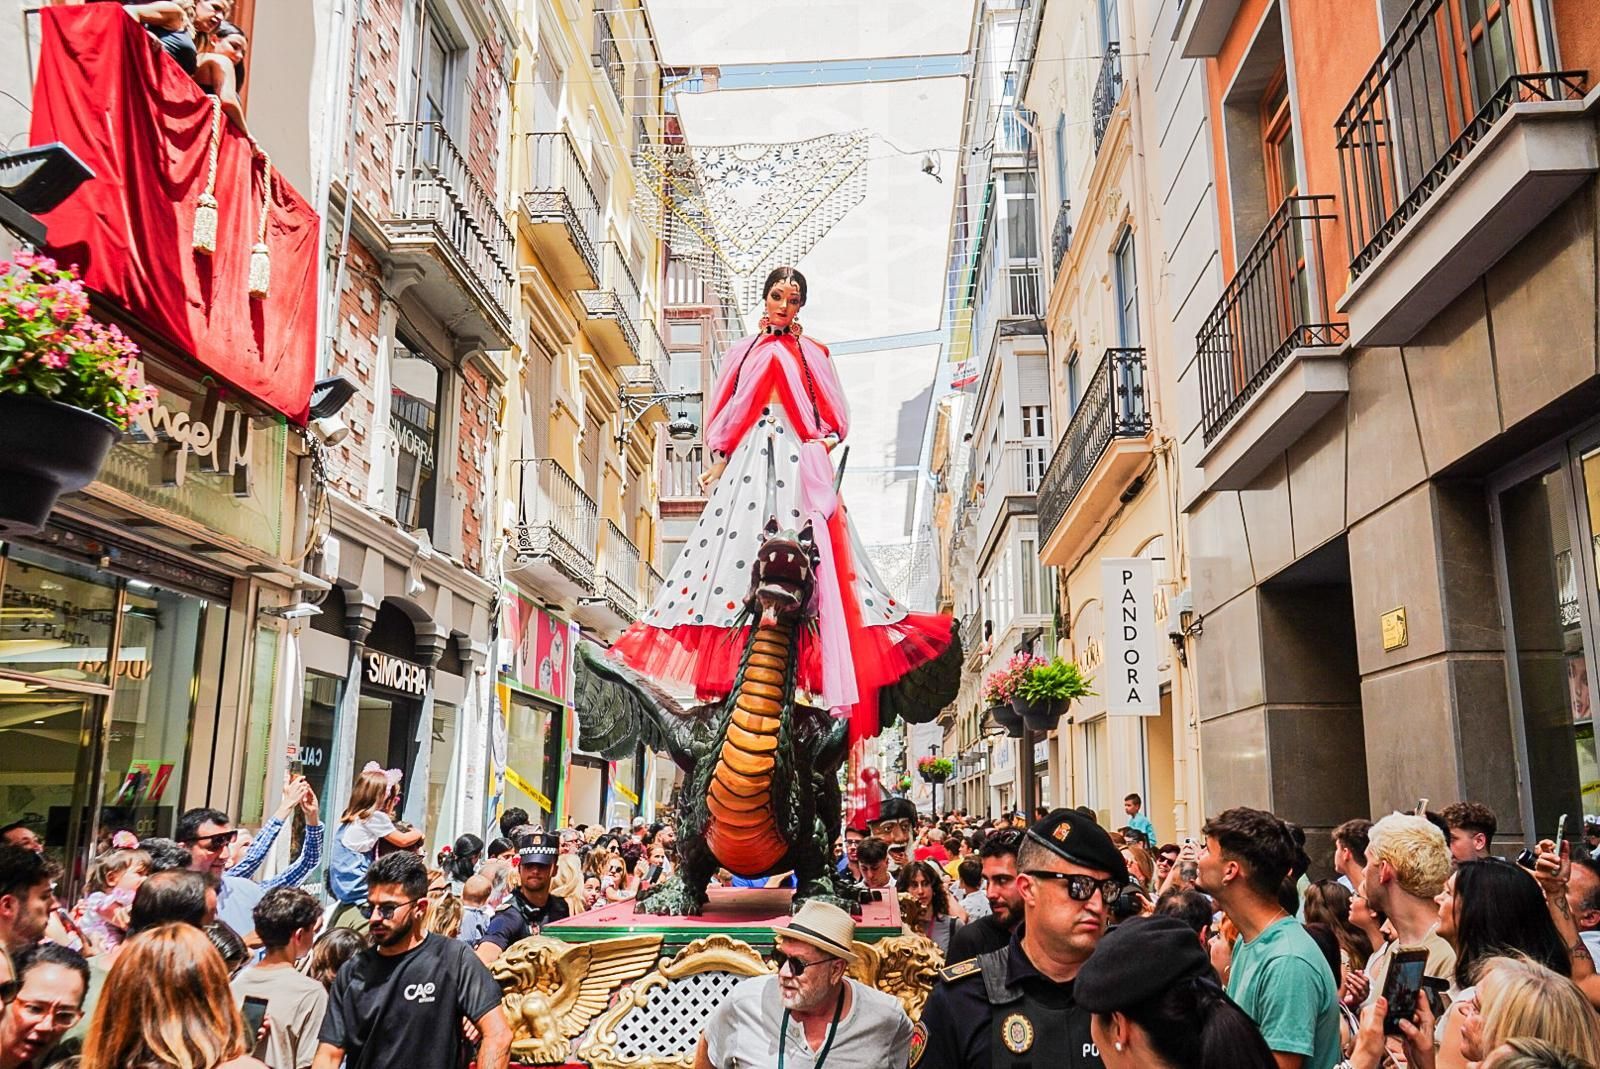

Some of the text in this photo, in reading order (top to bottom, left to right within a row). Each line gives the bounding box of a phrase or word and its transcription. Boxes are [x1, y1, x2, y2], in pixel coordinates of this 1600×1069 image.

[43, 622, 90, 647] PLANTA
[1121, 570, 1142, 704] PANDORA
[367, 652, 427, 696] SIMORRA
